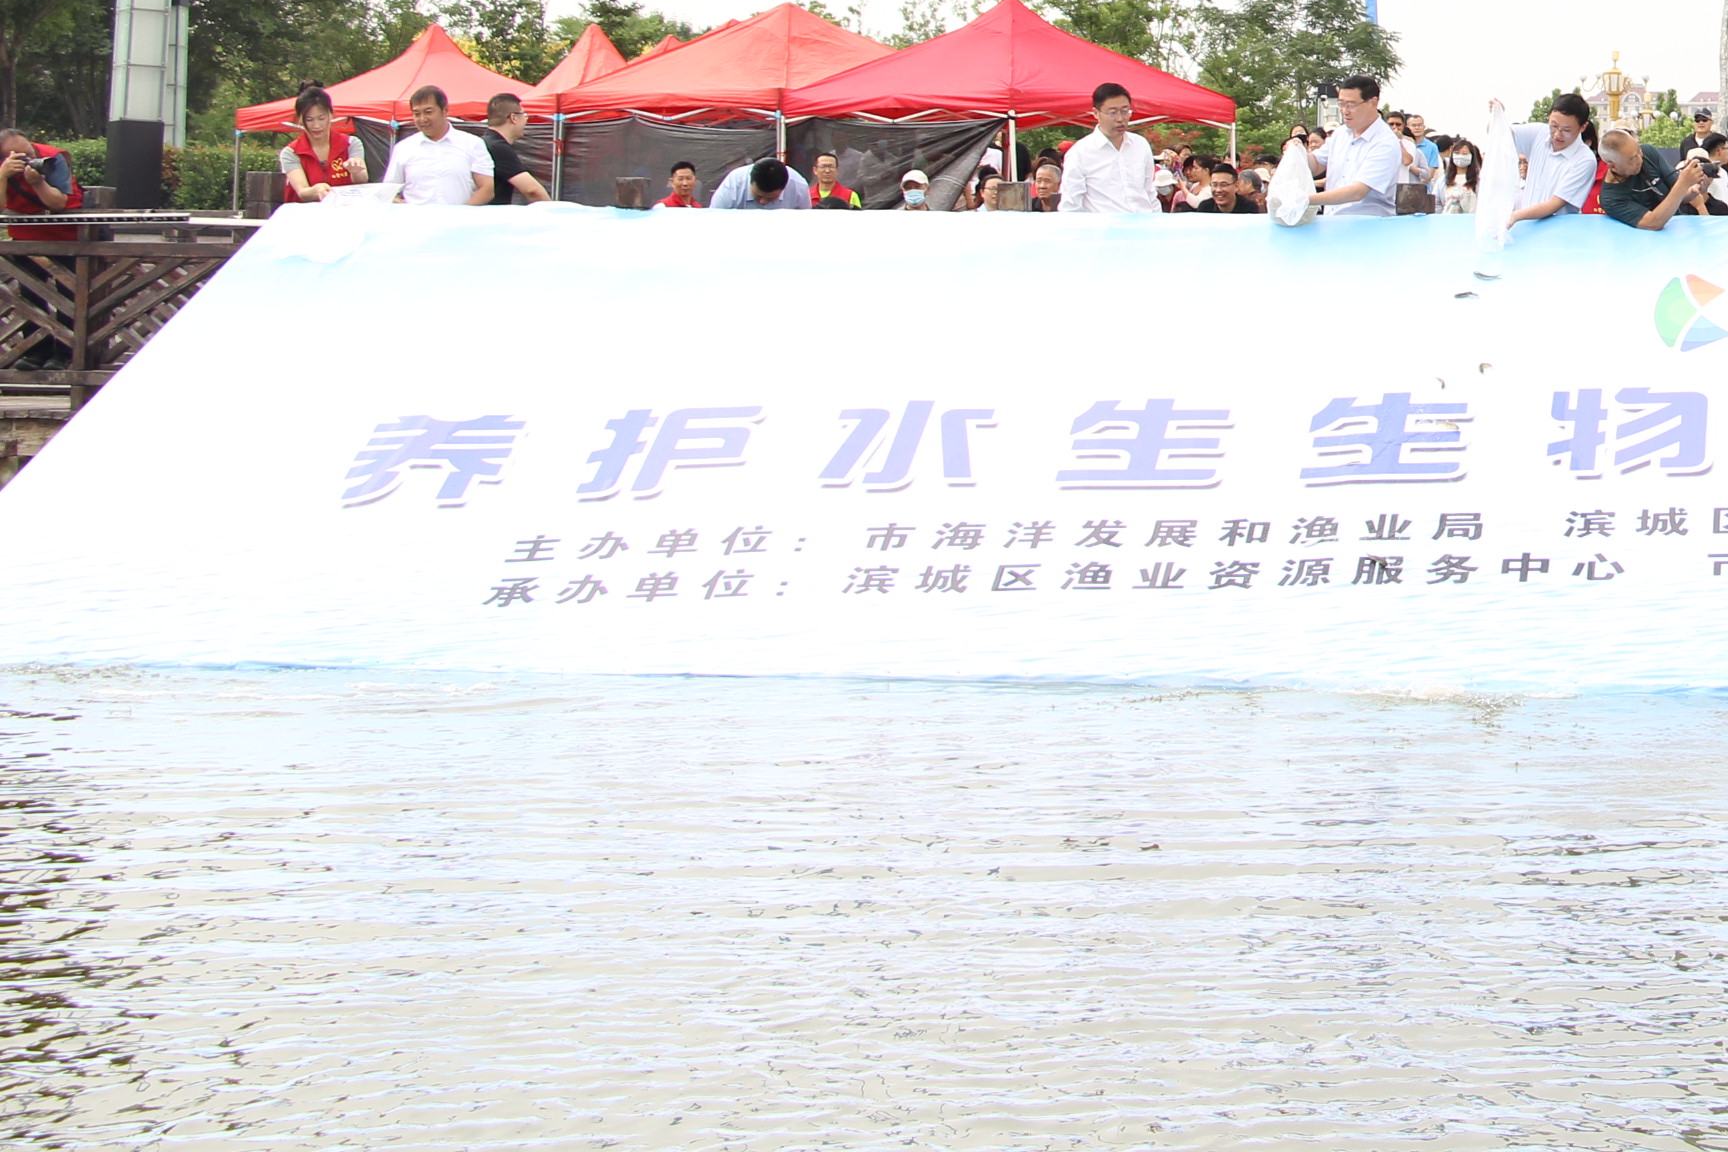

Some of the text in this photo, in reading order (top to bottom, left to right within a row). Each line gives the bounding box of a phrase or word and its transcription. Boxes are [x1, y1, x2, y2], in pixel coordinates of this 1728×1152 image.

[341, 388, 1713, 509] 养护水生生物
[866, 509, 1485, 551] 市海洋发展和渔业局
[843, 552, 1625, 595] 滨城区渔业资源服务中心
